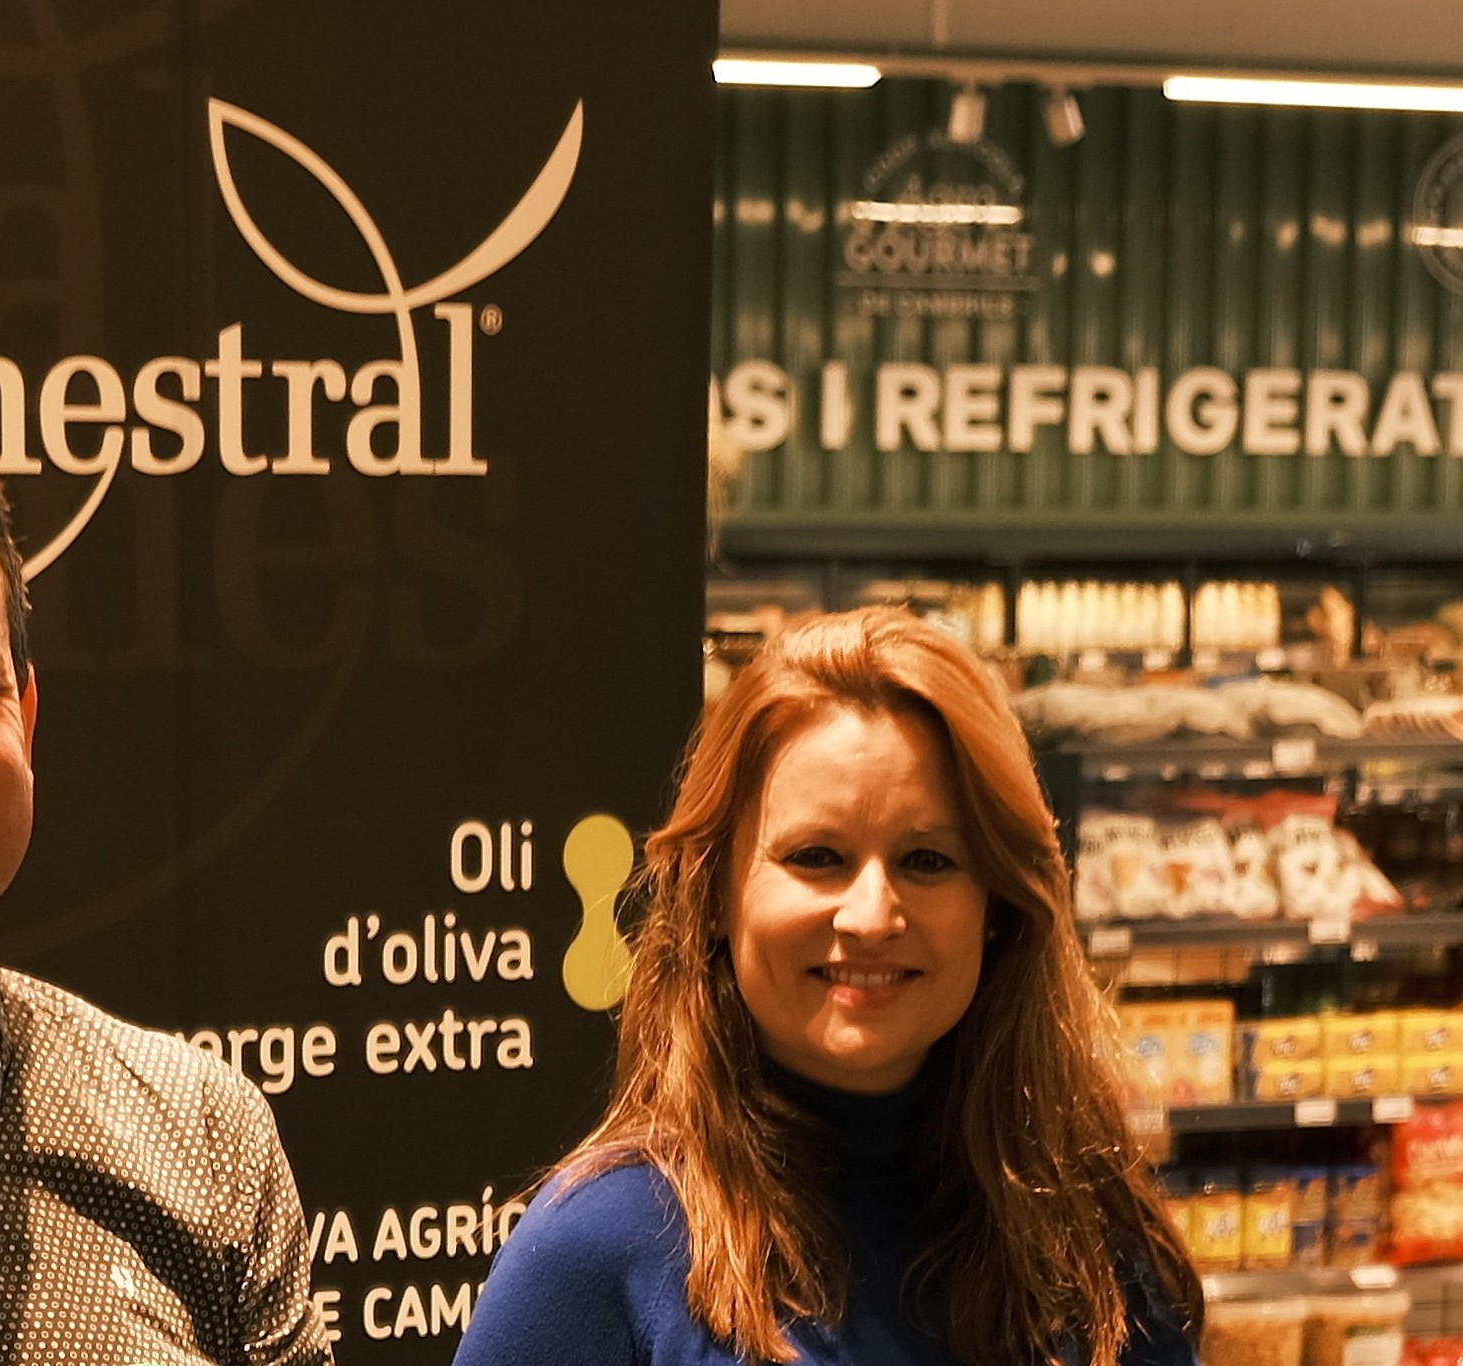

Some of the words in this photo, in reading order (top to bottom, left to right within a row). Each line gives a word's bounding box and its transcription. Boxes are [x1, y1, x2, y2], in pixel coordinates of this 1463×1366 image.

[711, 358, 794, 452] S
[821, 361, 851, 450] I
[450, 821, 535, 893] Oli
[191, 1024, 337, 1095] erge
[366, 1009, 535, 1076] extra
[363, 1282, 480, 1339] CAM
